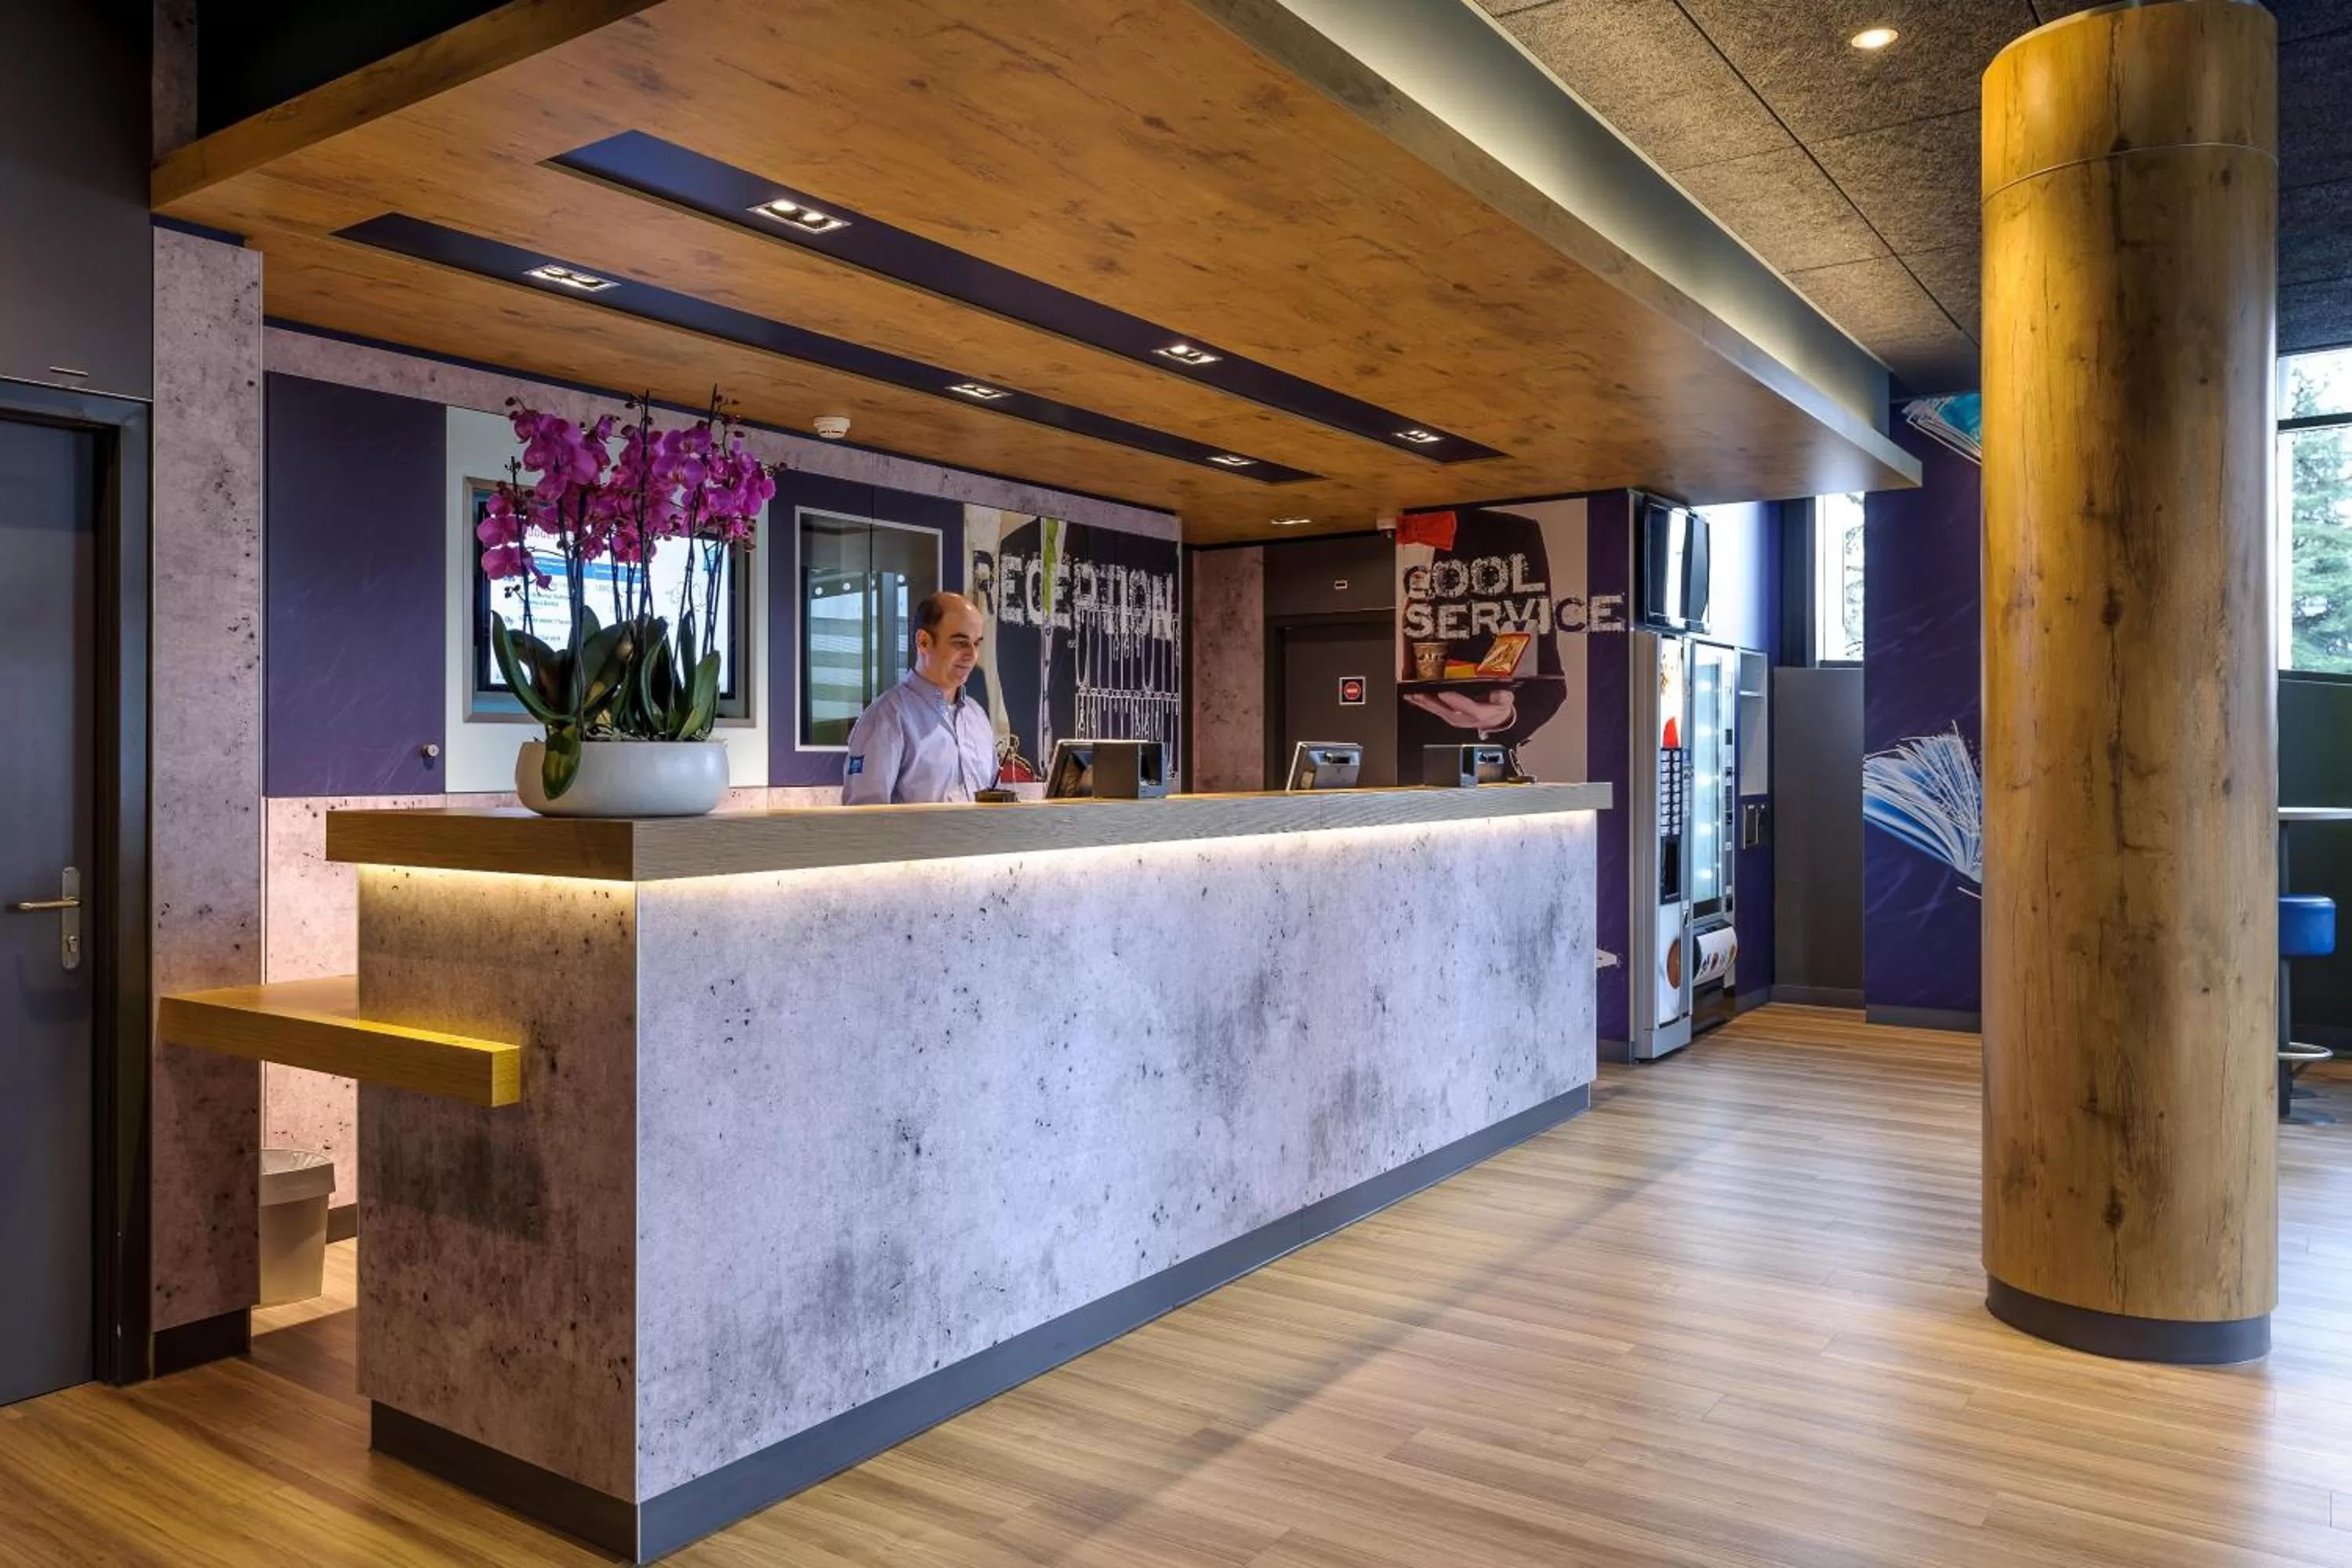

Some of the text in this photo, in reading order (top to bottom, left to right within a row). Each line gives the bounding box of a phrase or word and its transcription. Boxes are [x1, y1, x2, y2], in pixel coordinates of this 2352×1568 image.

[973, 550, 1174, 641] RECEPTION
[1403, 552, 1545, 599] COOL
[1403, 593, 1625, 639] SERVICE
